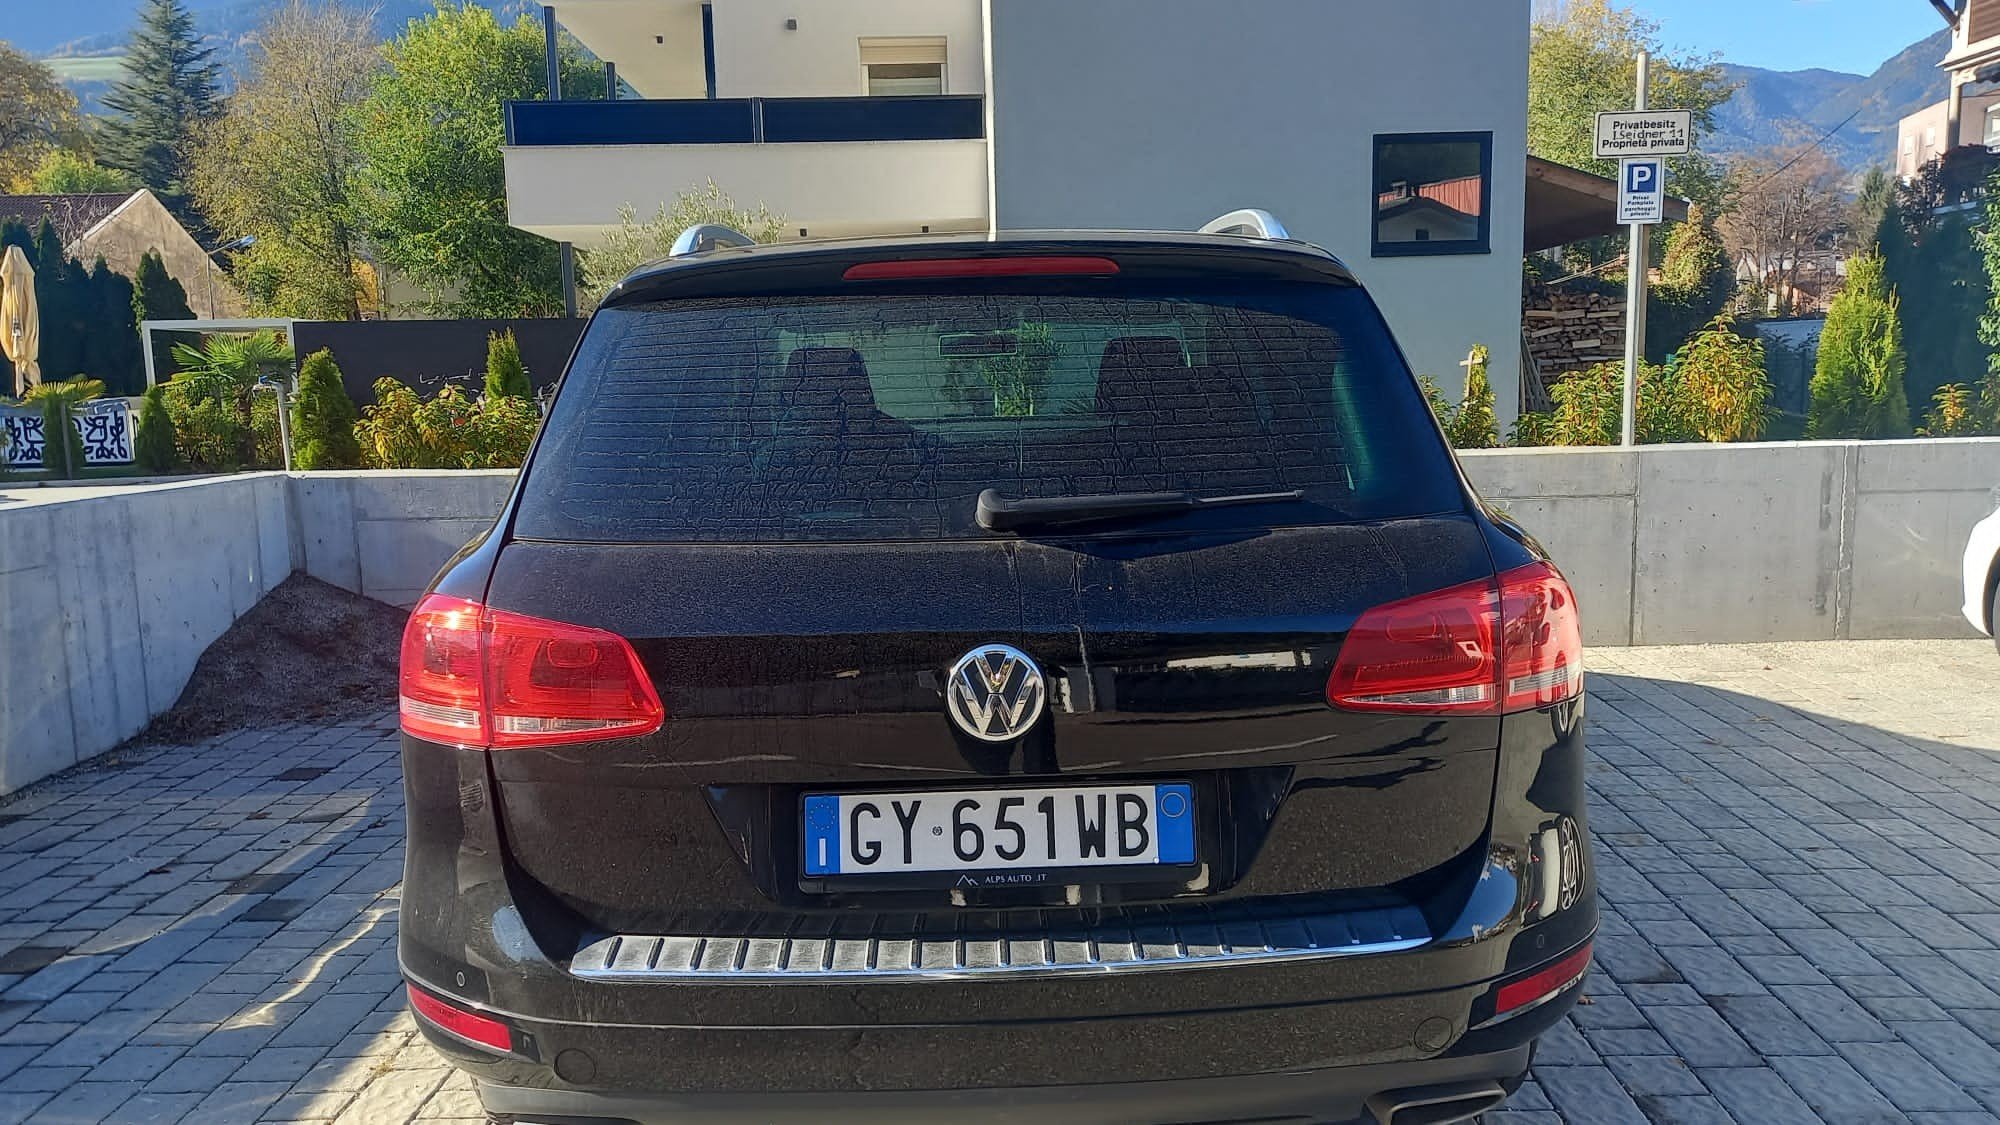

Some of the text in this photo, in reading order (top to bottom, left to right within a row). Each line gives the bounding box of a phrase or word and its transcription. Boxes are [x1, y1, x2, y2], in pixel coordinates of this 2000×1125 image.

[1613, 119, 1676, 129] Privatbesitz
[1650, 137, 1685, 149] privata
[1632, 166, 1651, 190] P
[850, 800, 922, 865] GY
[985, 875, 1006, 884] ALPS
